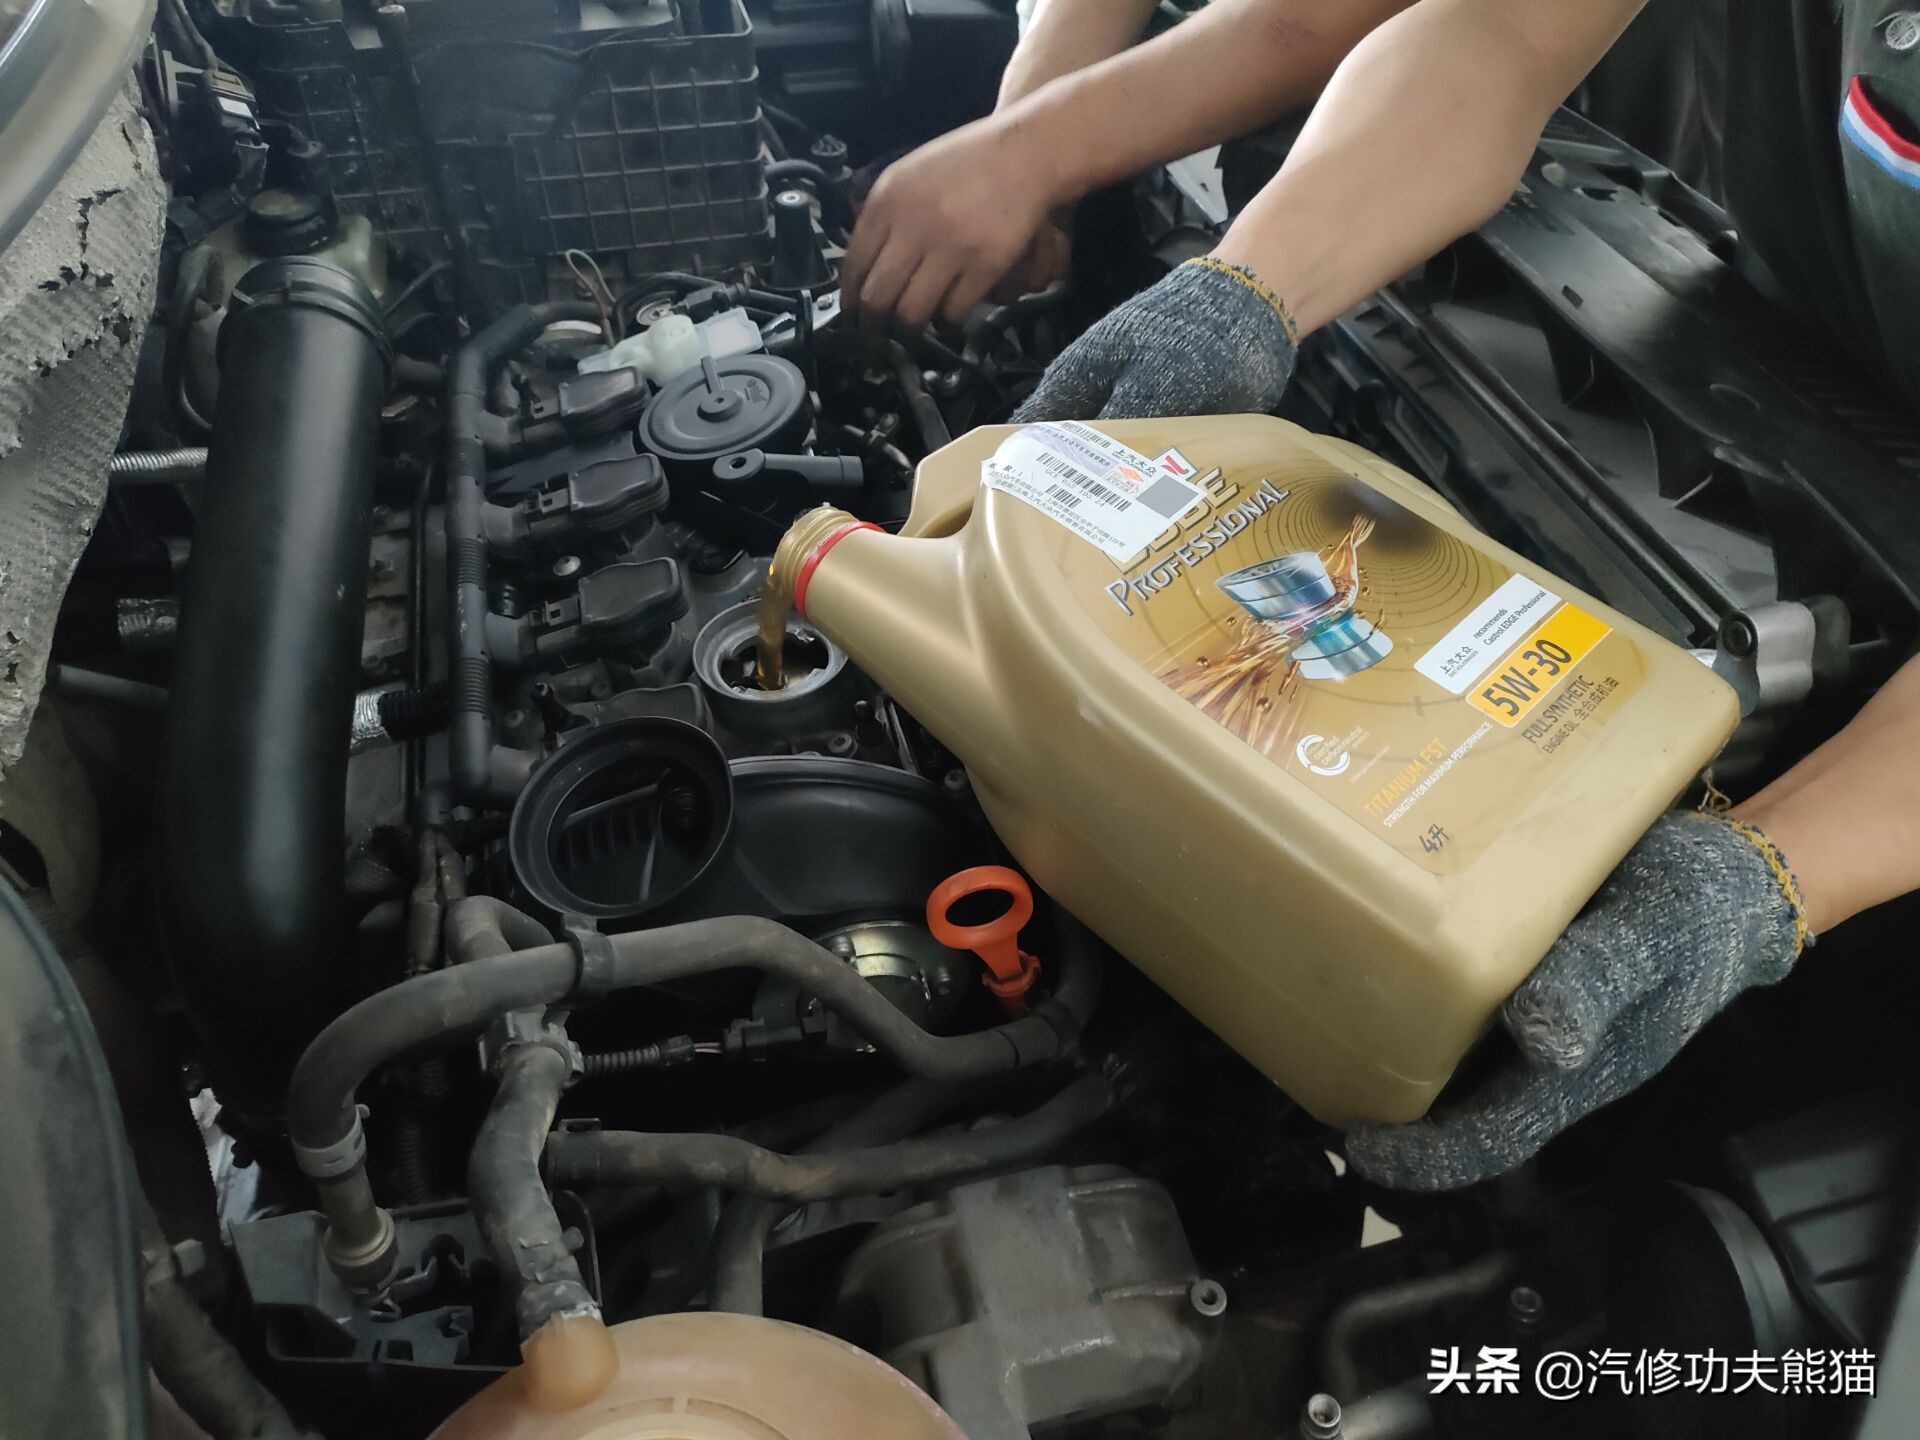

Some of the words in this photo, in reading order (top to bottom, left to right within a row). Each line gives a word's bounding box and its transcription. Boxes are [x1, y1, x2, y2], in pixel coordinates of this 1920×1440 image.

[1114, 449, 1157, 474] 上汽大众
[1104, 479, 1292, 617] PROFESSIONAL
[1473, 608, 1508, 639] recommends
[1483, 627, 1505, 646] Castrol
[1501, 613, 1519, 632] EDGE
[1514, 590, 1546, 617] Professional
[1440, 646, 1474, 674] 上汽大众
[1481, 639, 1572, 717] 5W-30
[1522, 718, 1554, 744] FULL
[1542, 675, 1595, 723] SYNTHETIC
[1542, 729, 1571, 754] ENGINE
[1563, 719, 1580, 733] OIL
[1574, 676, 1620, 720] 全合成机油
[1364, 758, 1427, 818] TITANIUM
[1420, 737, 1448, 765] FST
[1383, 796, 1417, 828] STRENGTH
[1412, 783, 1426, 800] FOR
[1423, 757, 1454, 788] MAXIMUM
[1448, 721, 1494, 760] PERFORMANCE
[1419, 823, 1450, 853] 4升
